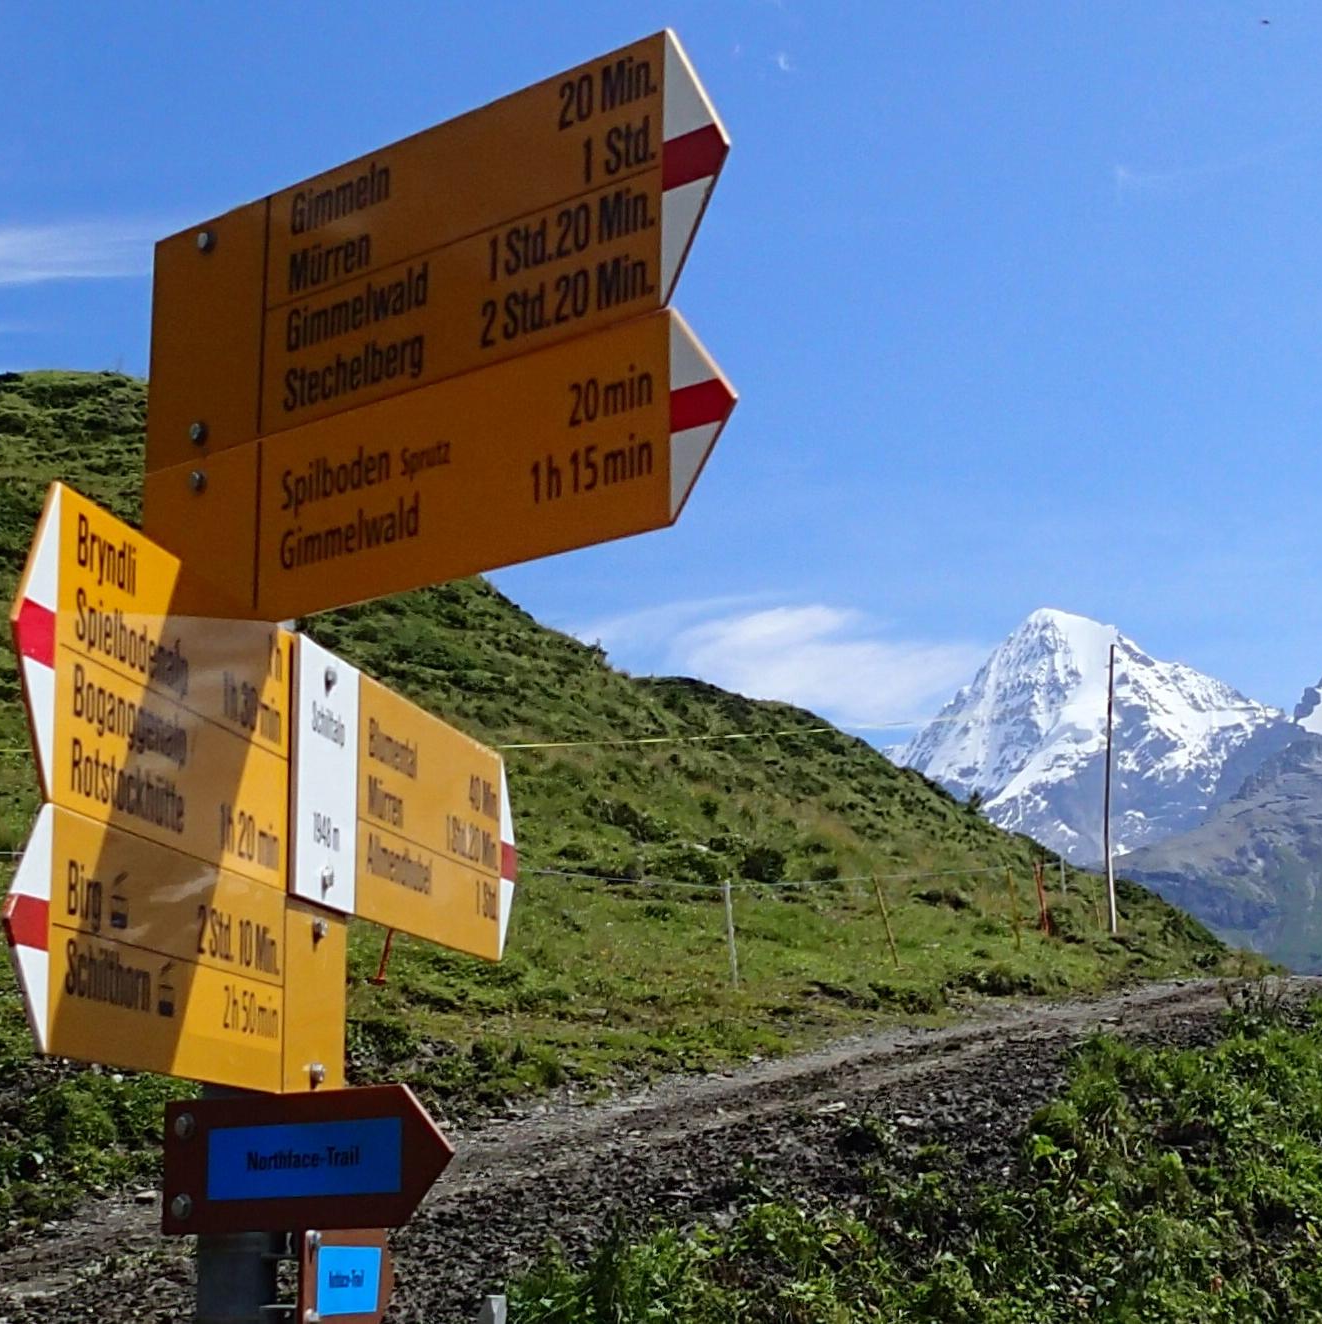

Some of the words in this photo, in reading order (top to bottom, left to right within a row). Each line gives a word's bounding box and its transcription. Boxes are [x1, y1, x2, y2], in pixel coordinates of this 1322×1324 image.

[290, 162, 390, 235] Gimmeln
[558, 73, 593, 131] 20
[601, 56, 657, 113] Min.
[289, 233, 370, 294] Mürren
[584, 136, 592, 184] 1
[604, 115, 656, 175] Std.
[286, 262, 428, 352] Gimmelwald
[598, 187, 655, 245] Min.
[284, 335, 424, 412] Stechelberg
[480, 299, 497, 348] 2
[597, 254, 654, 311] Min.
[281, 446, 390, 517] Spilboden
[400, 440, 450, 482] Sprutz
[77, 513, 136, 597] Bryndli
[280, 491, 419, 570] Gimmelwald
[71, 738, 184, 834] Rotstockhütte
[67, 859, 102, 933] Birg
[65, 938, 151, 1012] Schilthorn
